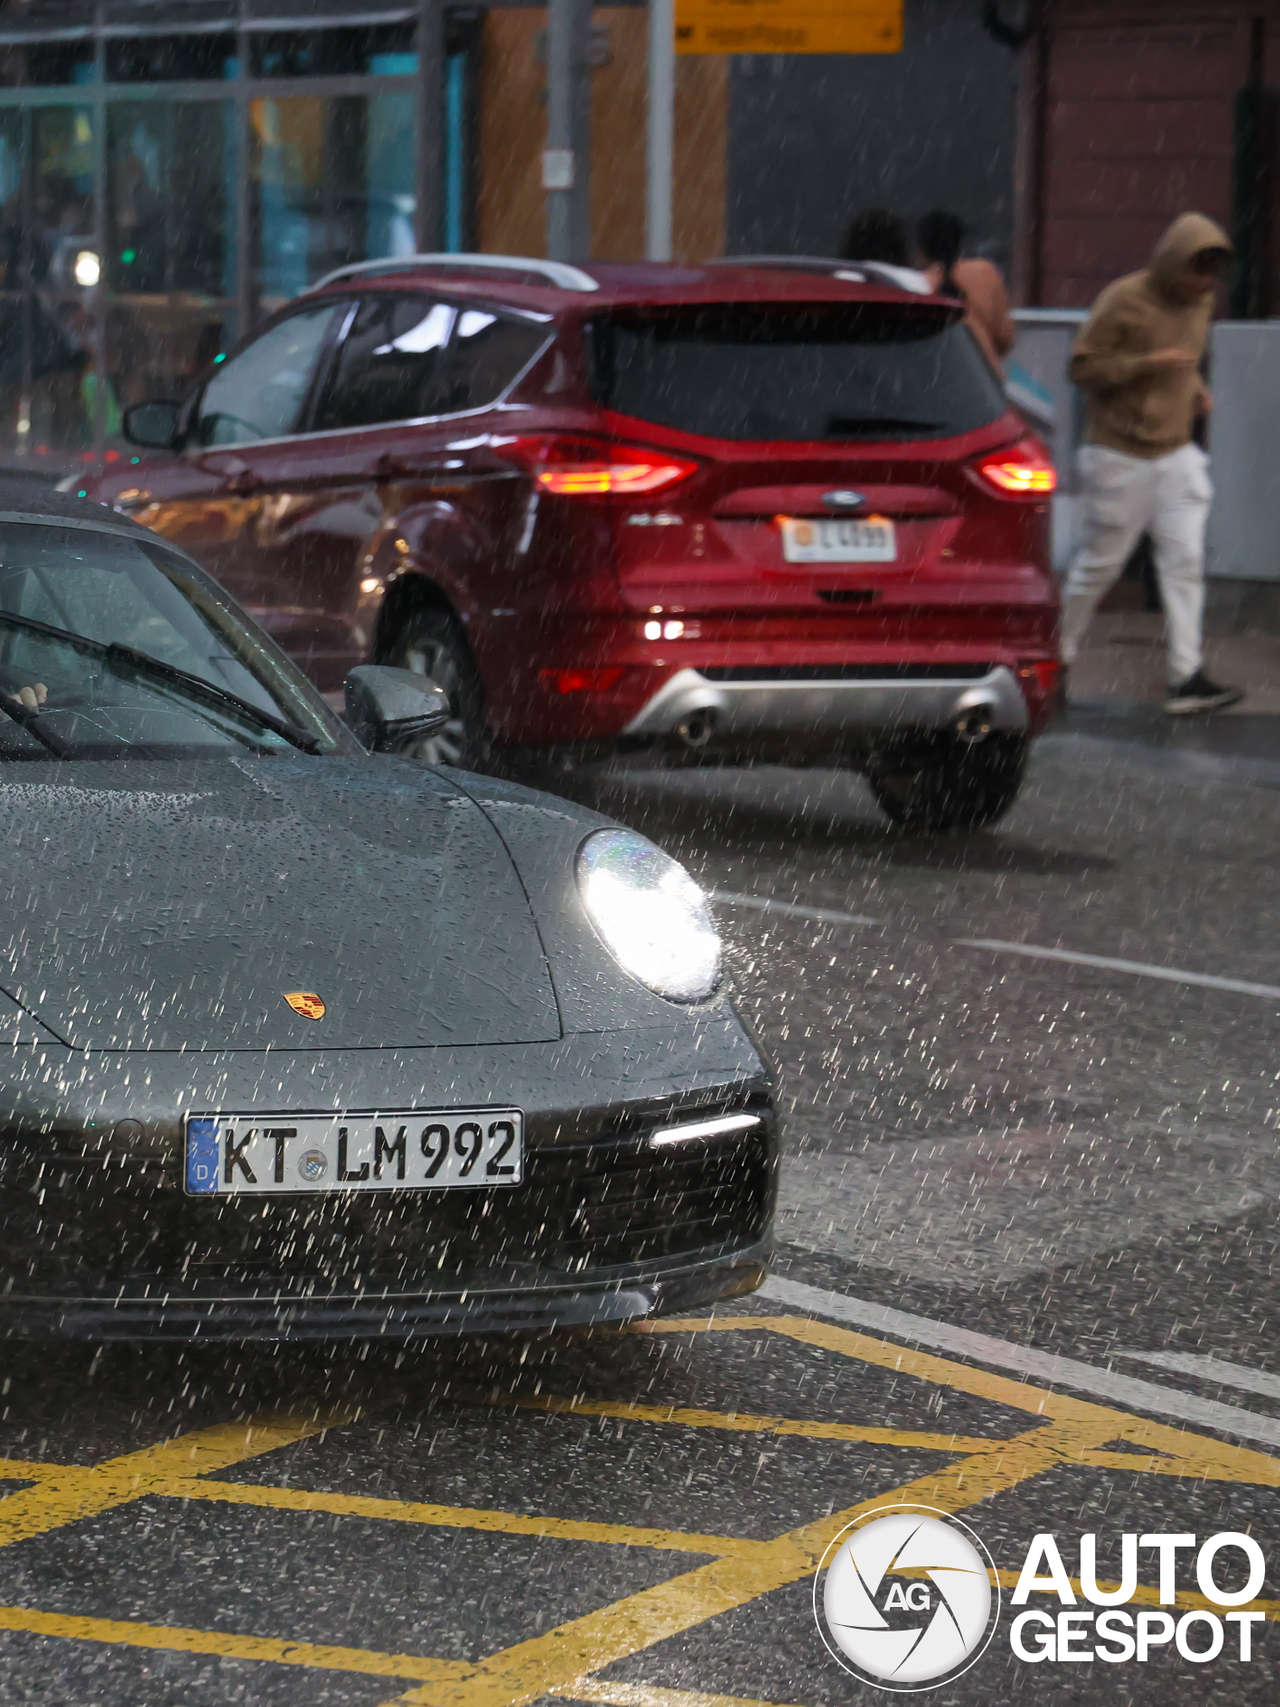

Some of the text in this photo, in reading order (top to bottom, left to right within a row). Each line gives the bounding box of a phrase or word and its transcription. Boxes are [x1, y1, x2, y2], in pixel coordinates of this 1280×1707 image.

[196, 1120, 516, 1184] D KT LM 992
